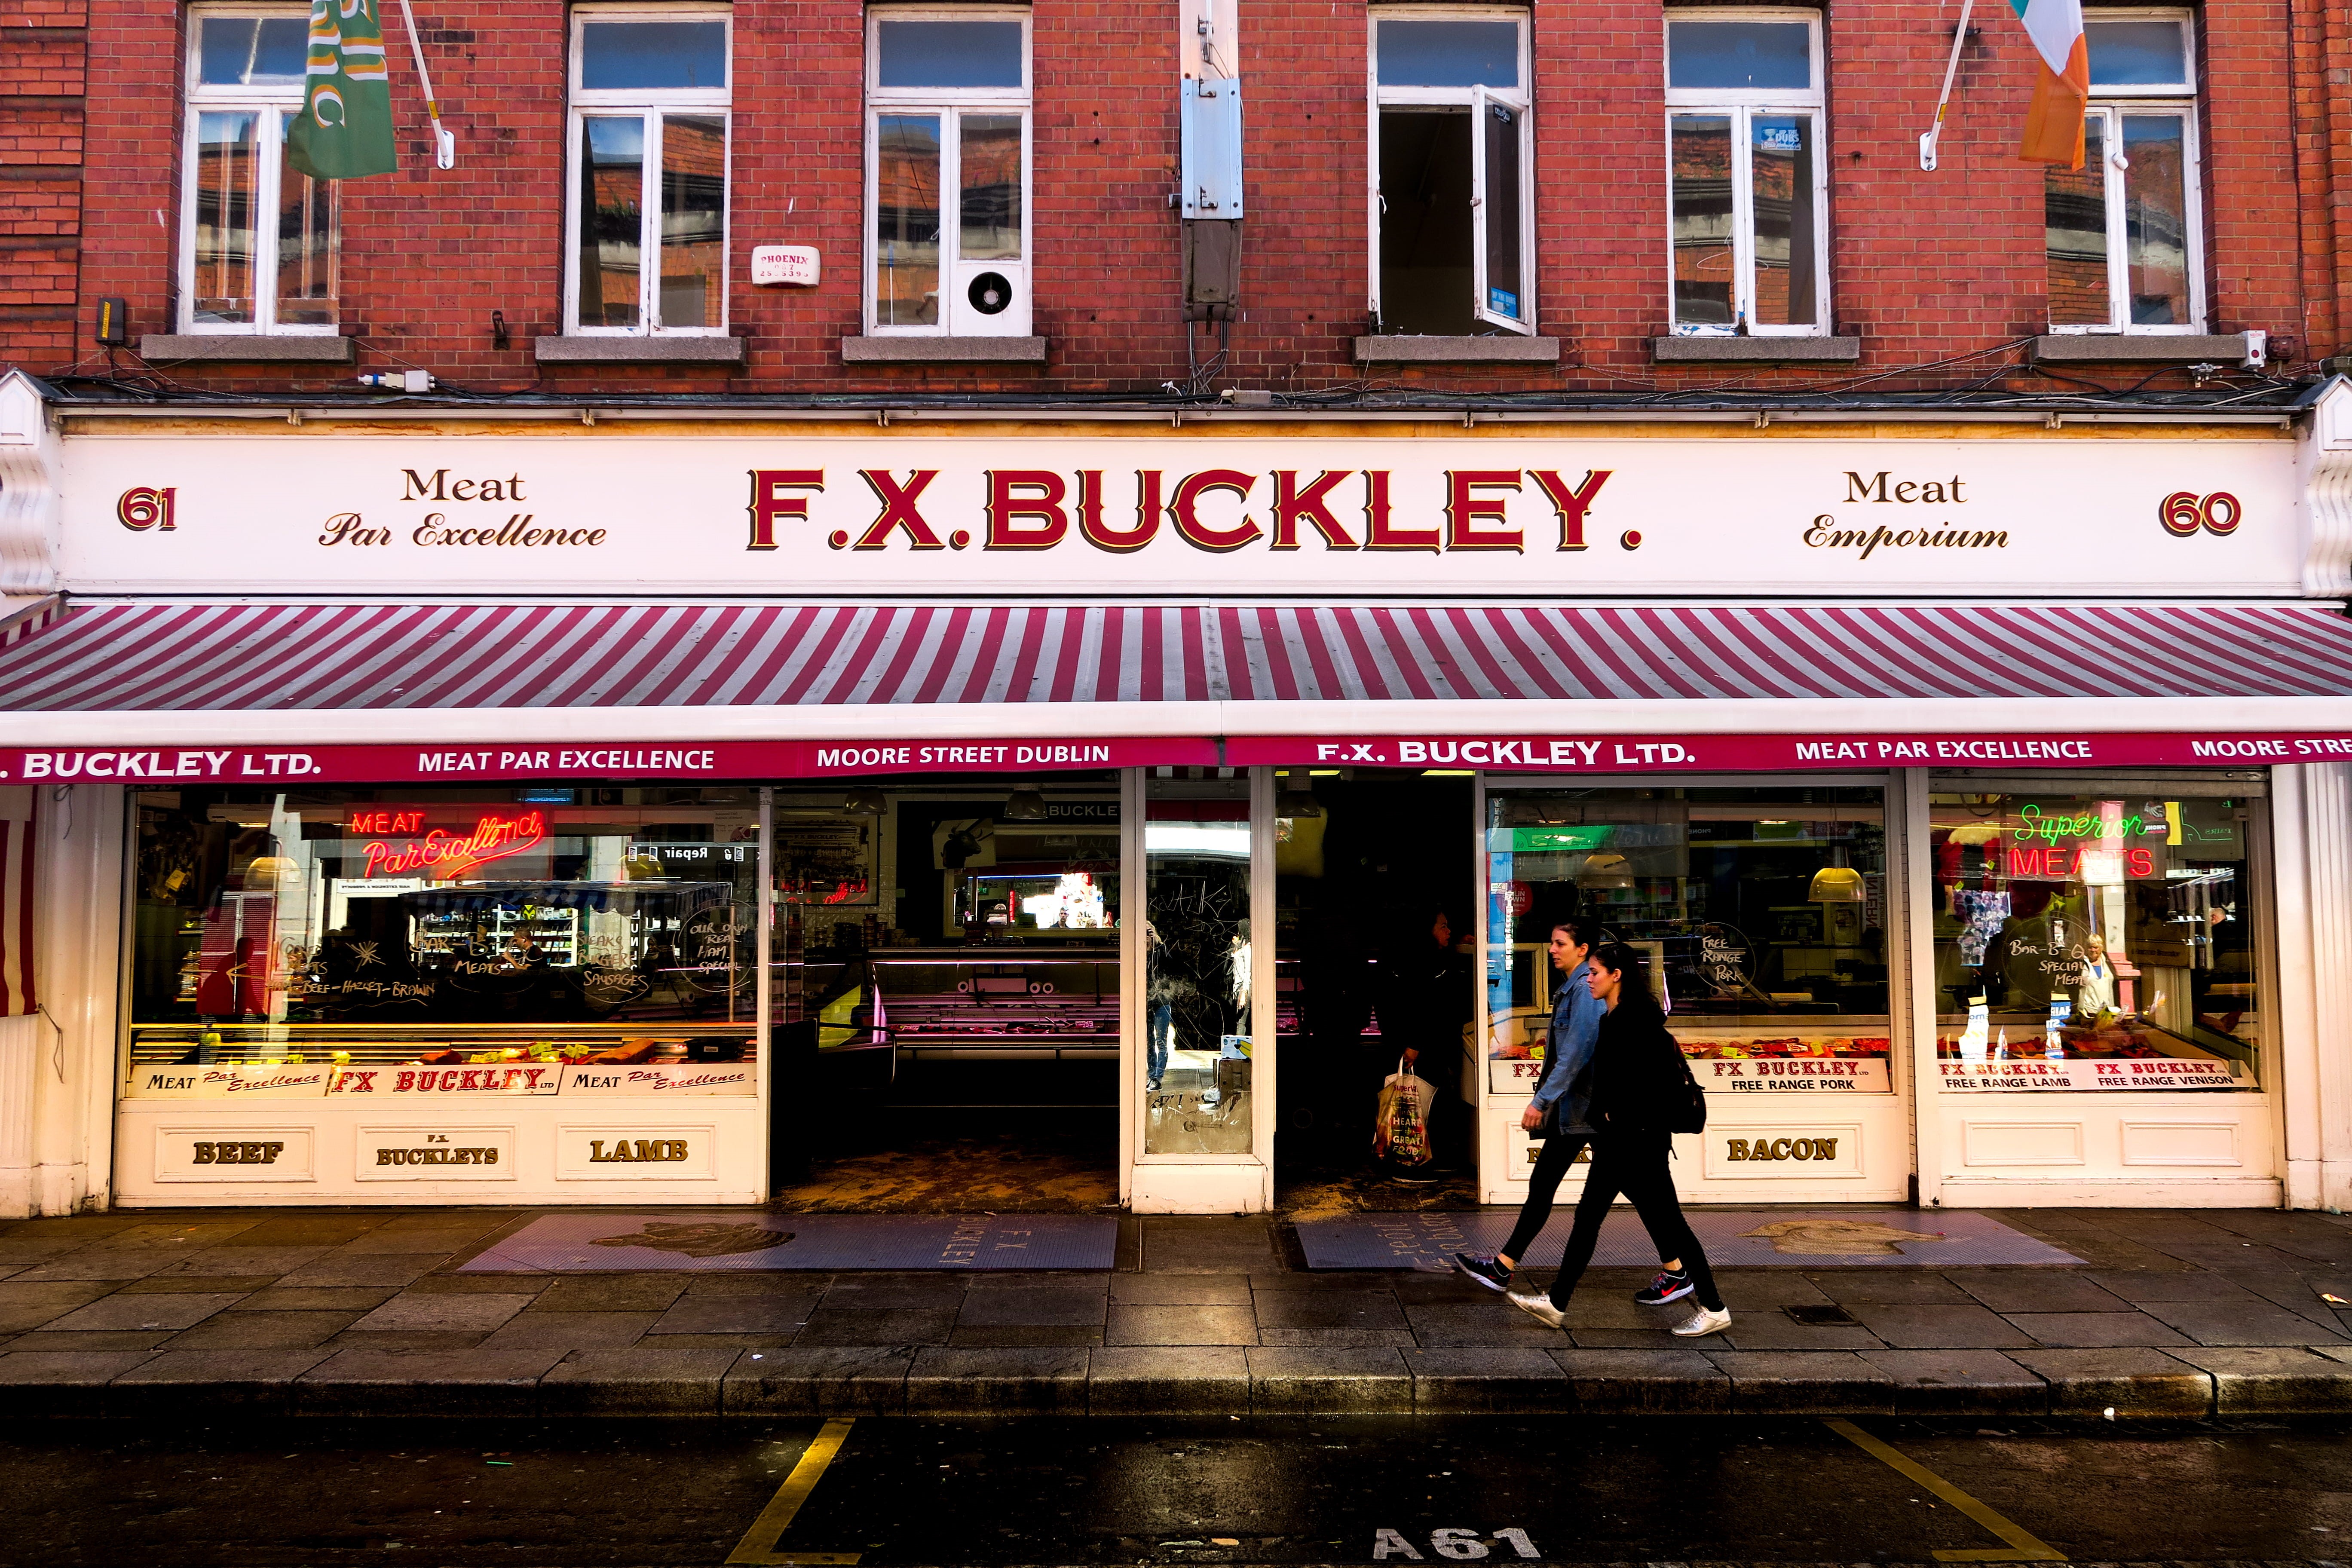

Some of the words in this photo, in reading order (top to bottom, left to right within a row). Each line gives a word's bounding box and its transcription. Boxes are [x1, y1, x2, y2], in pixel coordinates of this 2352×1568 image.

[760, 255, 809, 265] PHOENIX
[400, 469, 527, 502] Meat
[1842, 471, 1968, 504] Meat
[117, 486, 180, 532] 61
[2158, 490, 2242, 538] 60
[318, 511, 392, 547] Par
[412, 511, 606, 548] Excellence
[1803, 513, 2010, 561] Emporium
[817, 746, 911, 767] MOORE
[918, 745, 1009, 765] STREET
[1015, 744, 1111, 764] DUBLIN
[1316, 743, 1387, 763] F.X.
[1399, 740, 1603, 766] BUCKLEY
[1614, 742, 1697, 764] LTD.
[1795, 741, 1869, 762] MEAT
[1877, 740, 1929, 760] PAR
[1936, 739, 2094, 759] EXCELLENCE
[2190, 738, 2290, 758] MOORE
[2294, 739, 2352, 755] STRE
[22, 750, 234, 779] BUCKLEY
[241, 752, 322, 776] LTD.
[417, 751, 493, 773] MEAT
[498, 750, 551, 770] PAR
[557, 748, 715, 771] EXCELLENCE
[352, 813, 424, 833] MEAT
[2014, 804, 2148, 847] Superior
[362, 842, 423, 878] Par
[2011, 847, 2154, 878] MEATS
[689, 924, 717, 934] OUR
[704, 934, 741, 944] REAL
[1702, 935, 1730, 948] FREE
[697, 945, 727, 959] HAM
[1700, 948, 1743, 963] RANGE
[454, 960, 502, 975] MEATS
[1714, 964, 1743, 983] PORK
[583, 970, 649, 991] SAUSAGES
[1513, 1063, 1541, 1078] FX
[1713, 1062, 1745, 1077] FX
[1756, 1060, 1860, 1077] BUCKLEY
[1939, 1063, 1966, 1076] FX
[1975, 1063, 2061, 1076] BUCKLEY
[2094, 1063, 2122, 1075] FX
[2131, 1063, 2217, 1074] BUCKLEY
[146, 1074, 196, 1090] MEAT
[203, 1071, 238, 1083] Par
[227, 1073, 321, 1092] Excellence
[332, 1071, 378, 1093] FX
[393, 1068, 546, 1092] BUCKLEY
[572, 1073, 622, 1089] MEAT
[628, 1070, 662, 1082] Par
[653, 1071, 746, 1091] Excellence
[1732, 1079, 1764, 1090] FREE
[1767, 1079, 1816, 1090] RANGE
[1819, 1078, 1856, 1090] PORK
[1945, 1078, 1977, 1089] FREE
[1982, 1078, 2029, 1088] RANGE
[2032, 1077, 2071, 1087] LAMB
[2098, 1076, 2128, 1087] FREE
[2131, 1076, 2174, 1087] RANGE
[2174, 1075, 2235, 1086] VENISON
[193, 1141, 284, 1165] BEEF
[376, 1147, 499, 1166] BUCKLEYS
[589, 1139, 689, 1163] LAMB
[1392, 1145, 1419, 1156] FOOD
[1726, 1137, 1839, 1161] BACON
[938, 1216, 993, 1265] BUCKLEY
[1373, 1527, 1542, 1560] A61
